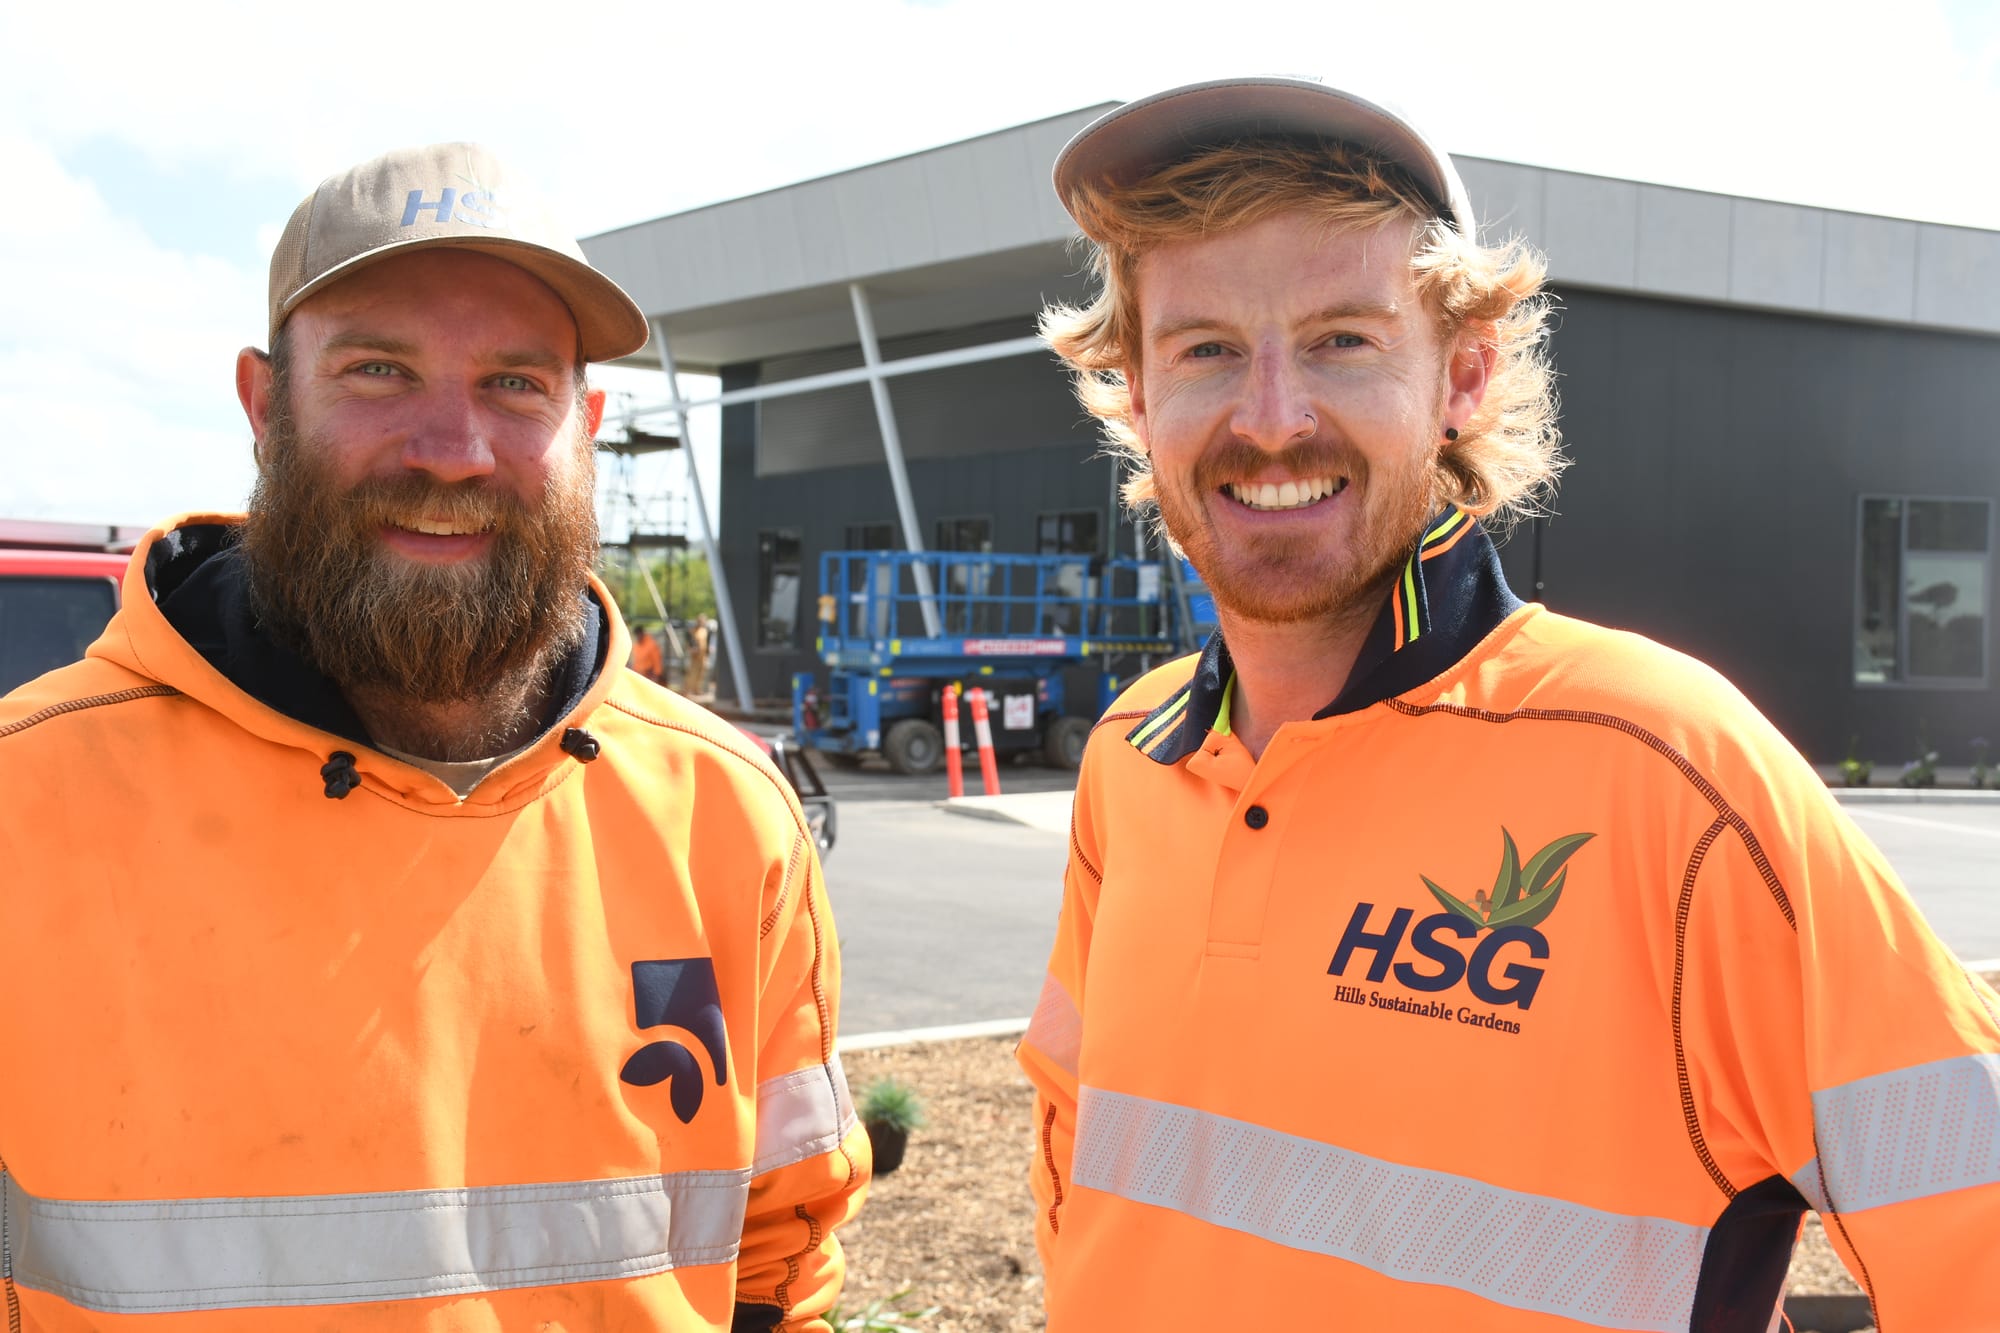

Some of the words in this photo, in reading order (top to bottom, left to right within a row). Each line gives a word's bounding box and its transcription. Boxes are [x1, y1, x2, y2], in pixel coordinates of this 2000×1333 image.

[1327, 902, 1550, 1010] HSG
[1333, 985, 1366, 1006] Hills
[1369, 991, 1453, 1021] Sustainable
[1456, 1007, 1521, 1035] Gardens
